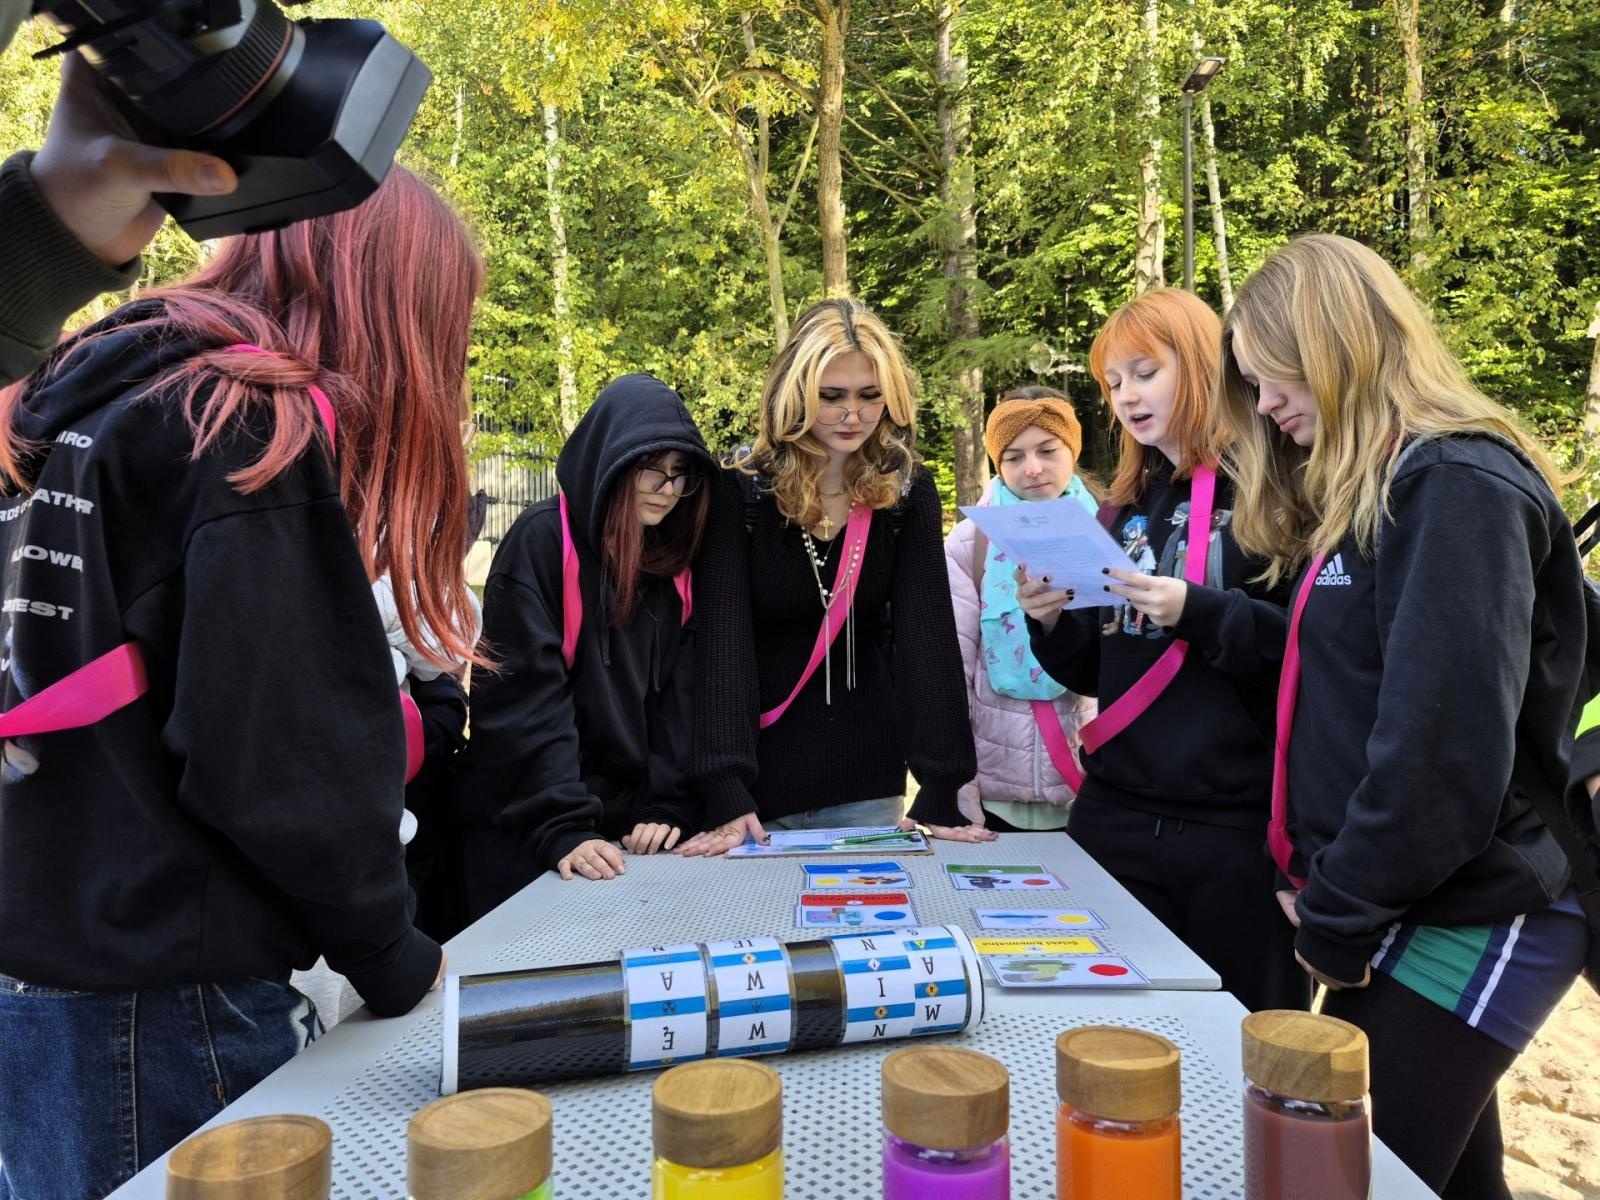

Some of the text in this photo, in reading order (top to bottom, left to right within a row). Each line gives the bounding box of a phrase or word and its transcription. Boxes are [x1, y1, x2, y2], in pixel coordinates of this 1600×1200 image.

[1315, 573, 1352, 586] adidas
[921, 956, 934, 975] A
[660, 971, 673, 991] A
[746, 970, 766, 991] W
[876, 977, 886, 998] I
[924, 1003, 942, 1022] M
[662, 1026, 675, 1051] Ę
[748, 1021, 767, 1041] W
[873, 1023, 888, 1038] N
